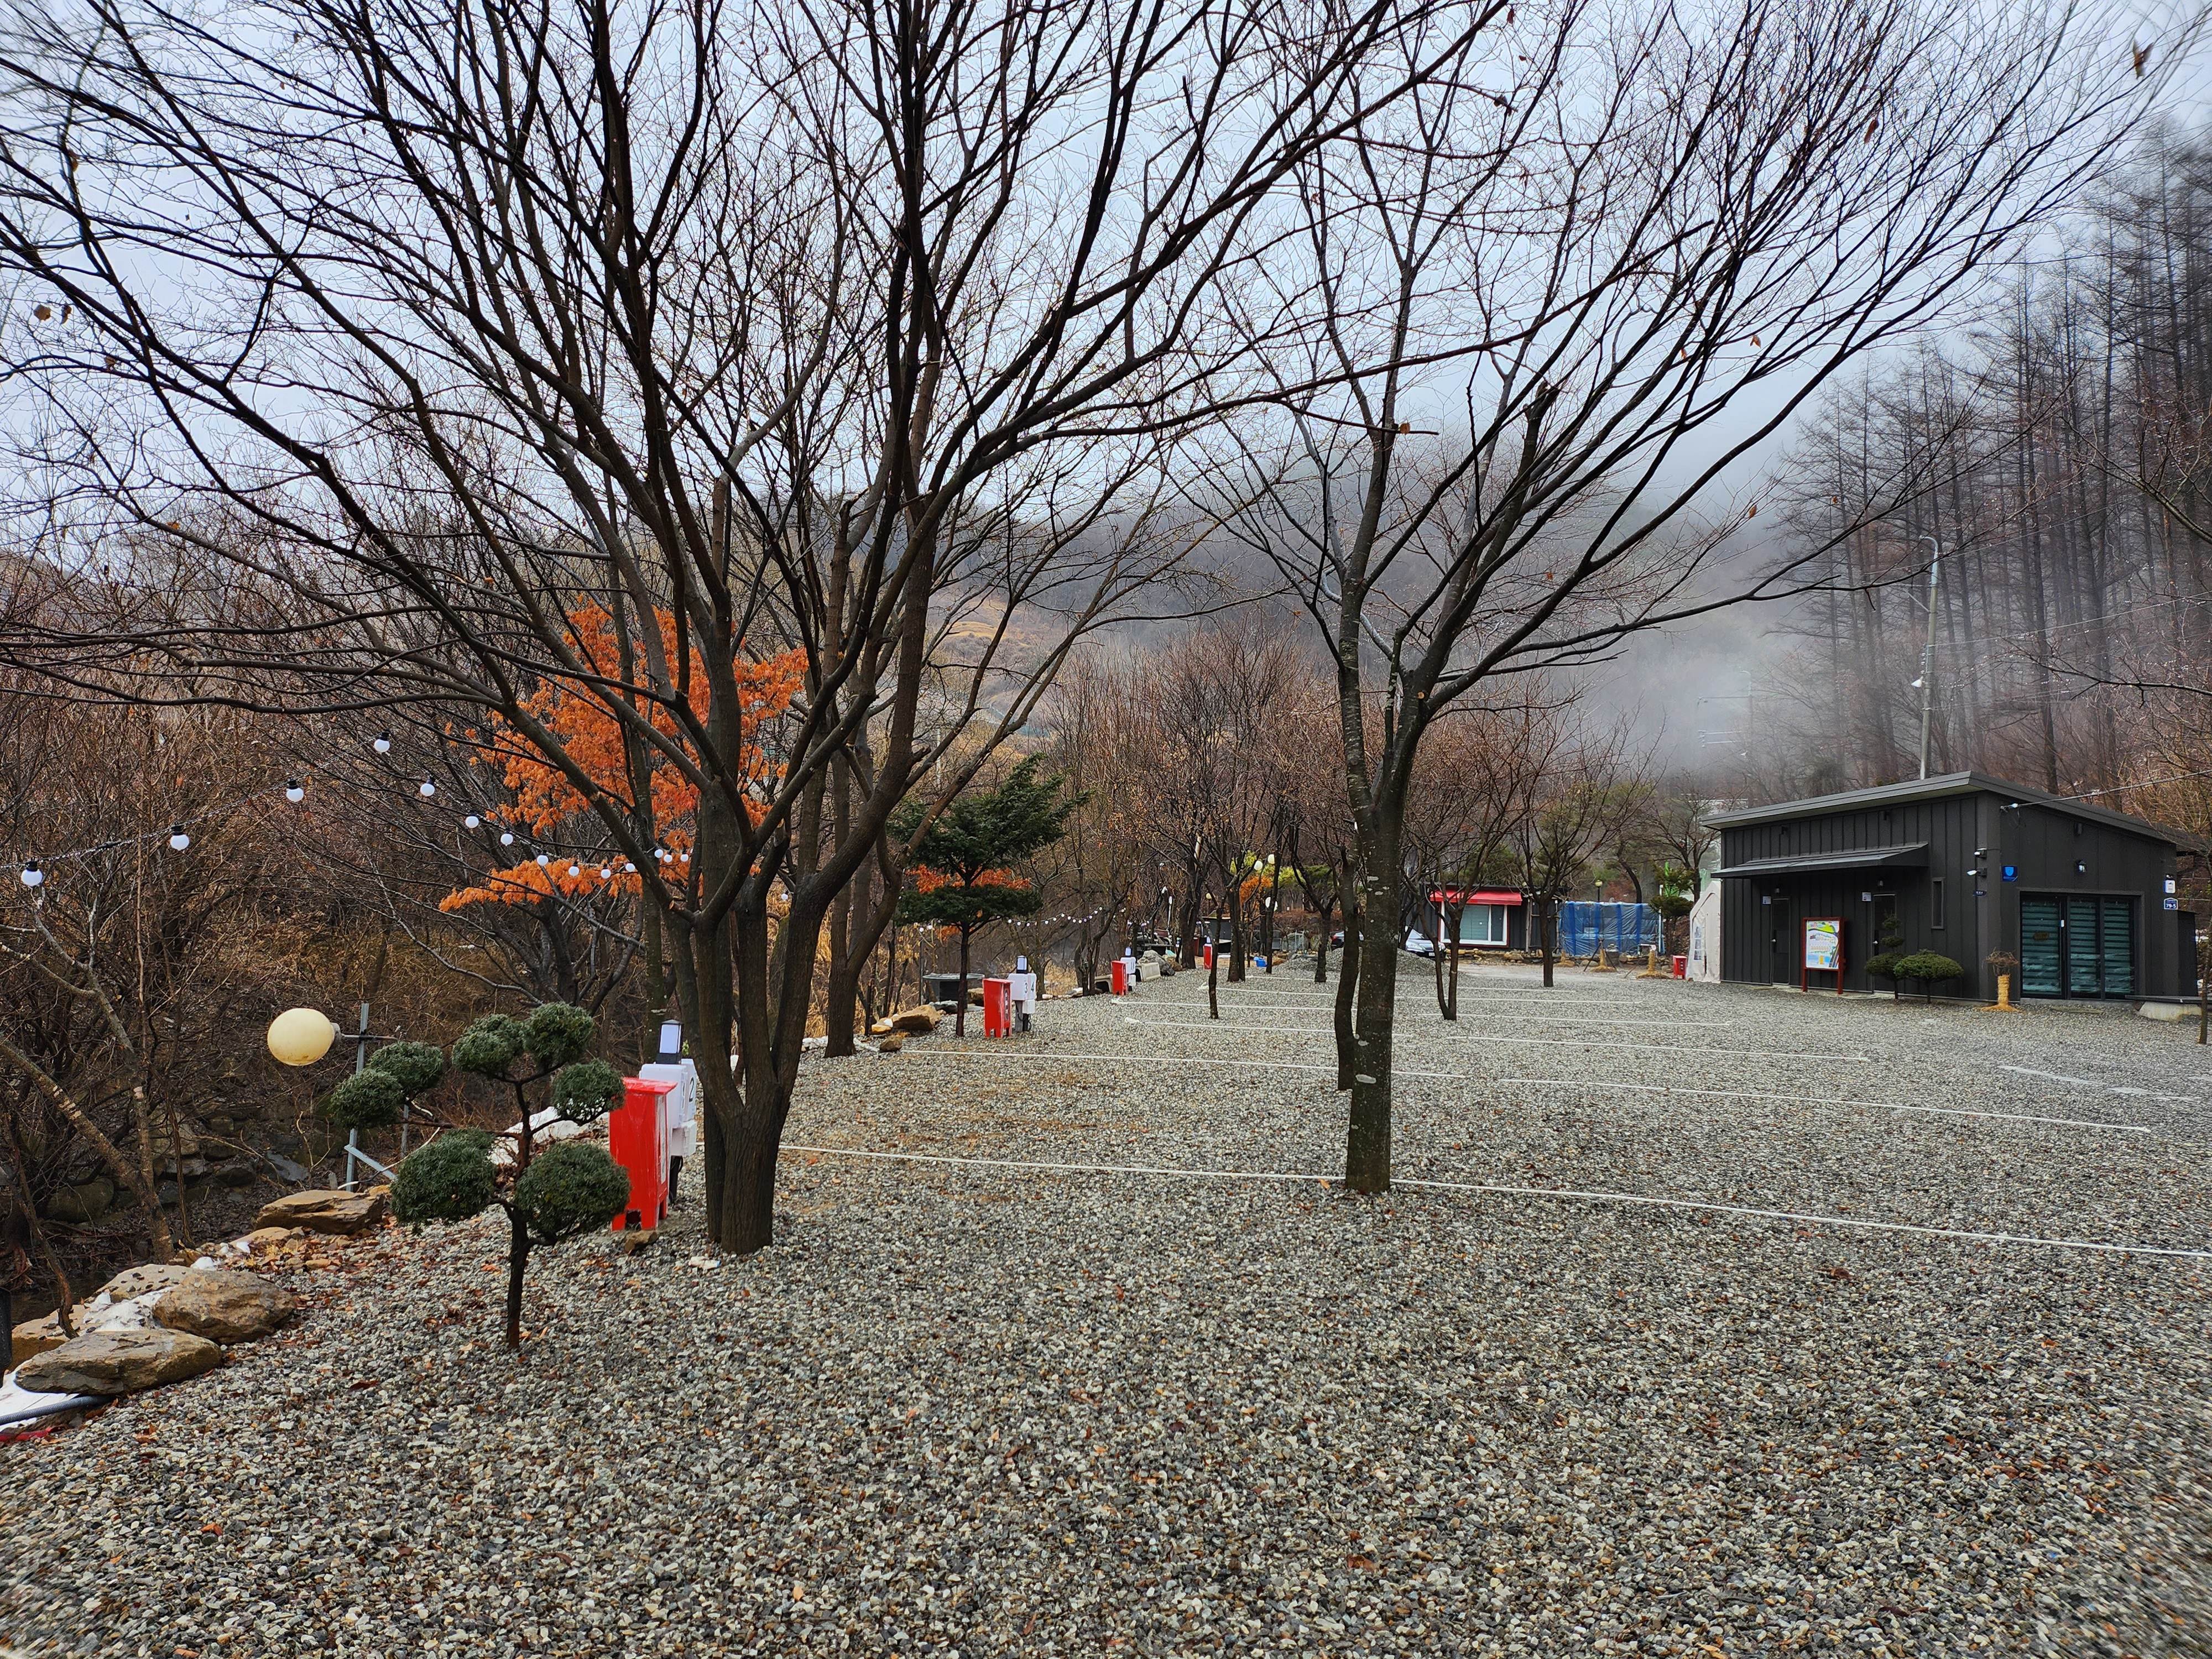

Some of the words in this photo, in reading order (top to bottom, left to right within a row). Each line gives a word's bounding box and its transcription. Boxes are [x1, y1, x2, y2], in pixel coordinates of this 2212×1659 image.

[1025, 983, 1028, 993] 3
[1031, 982, 1034, 993] 4
[688, 1077, 695, 1103] 2
